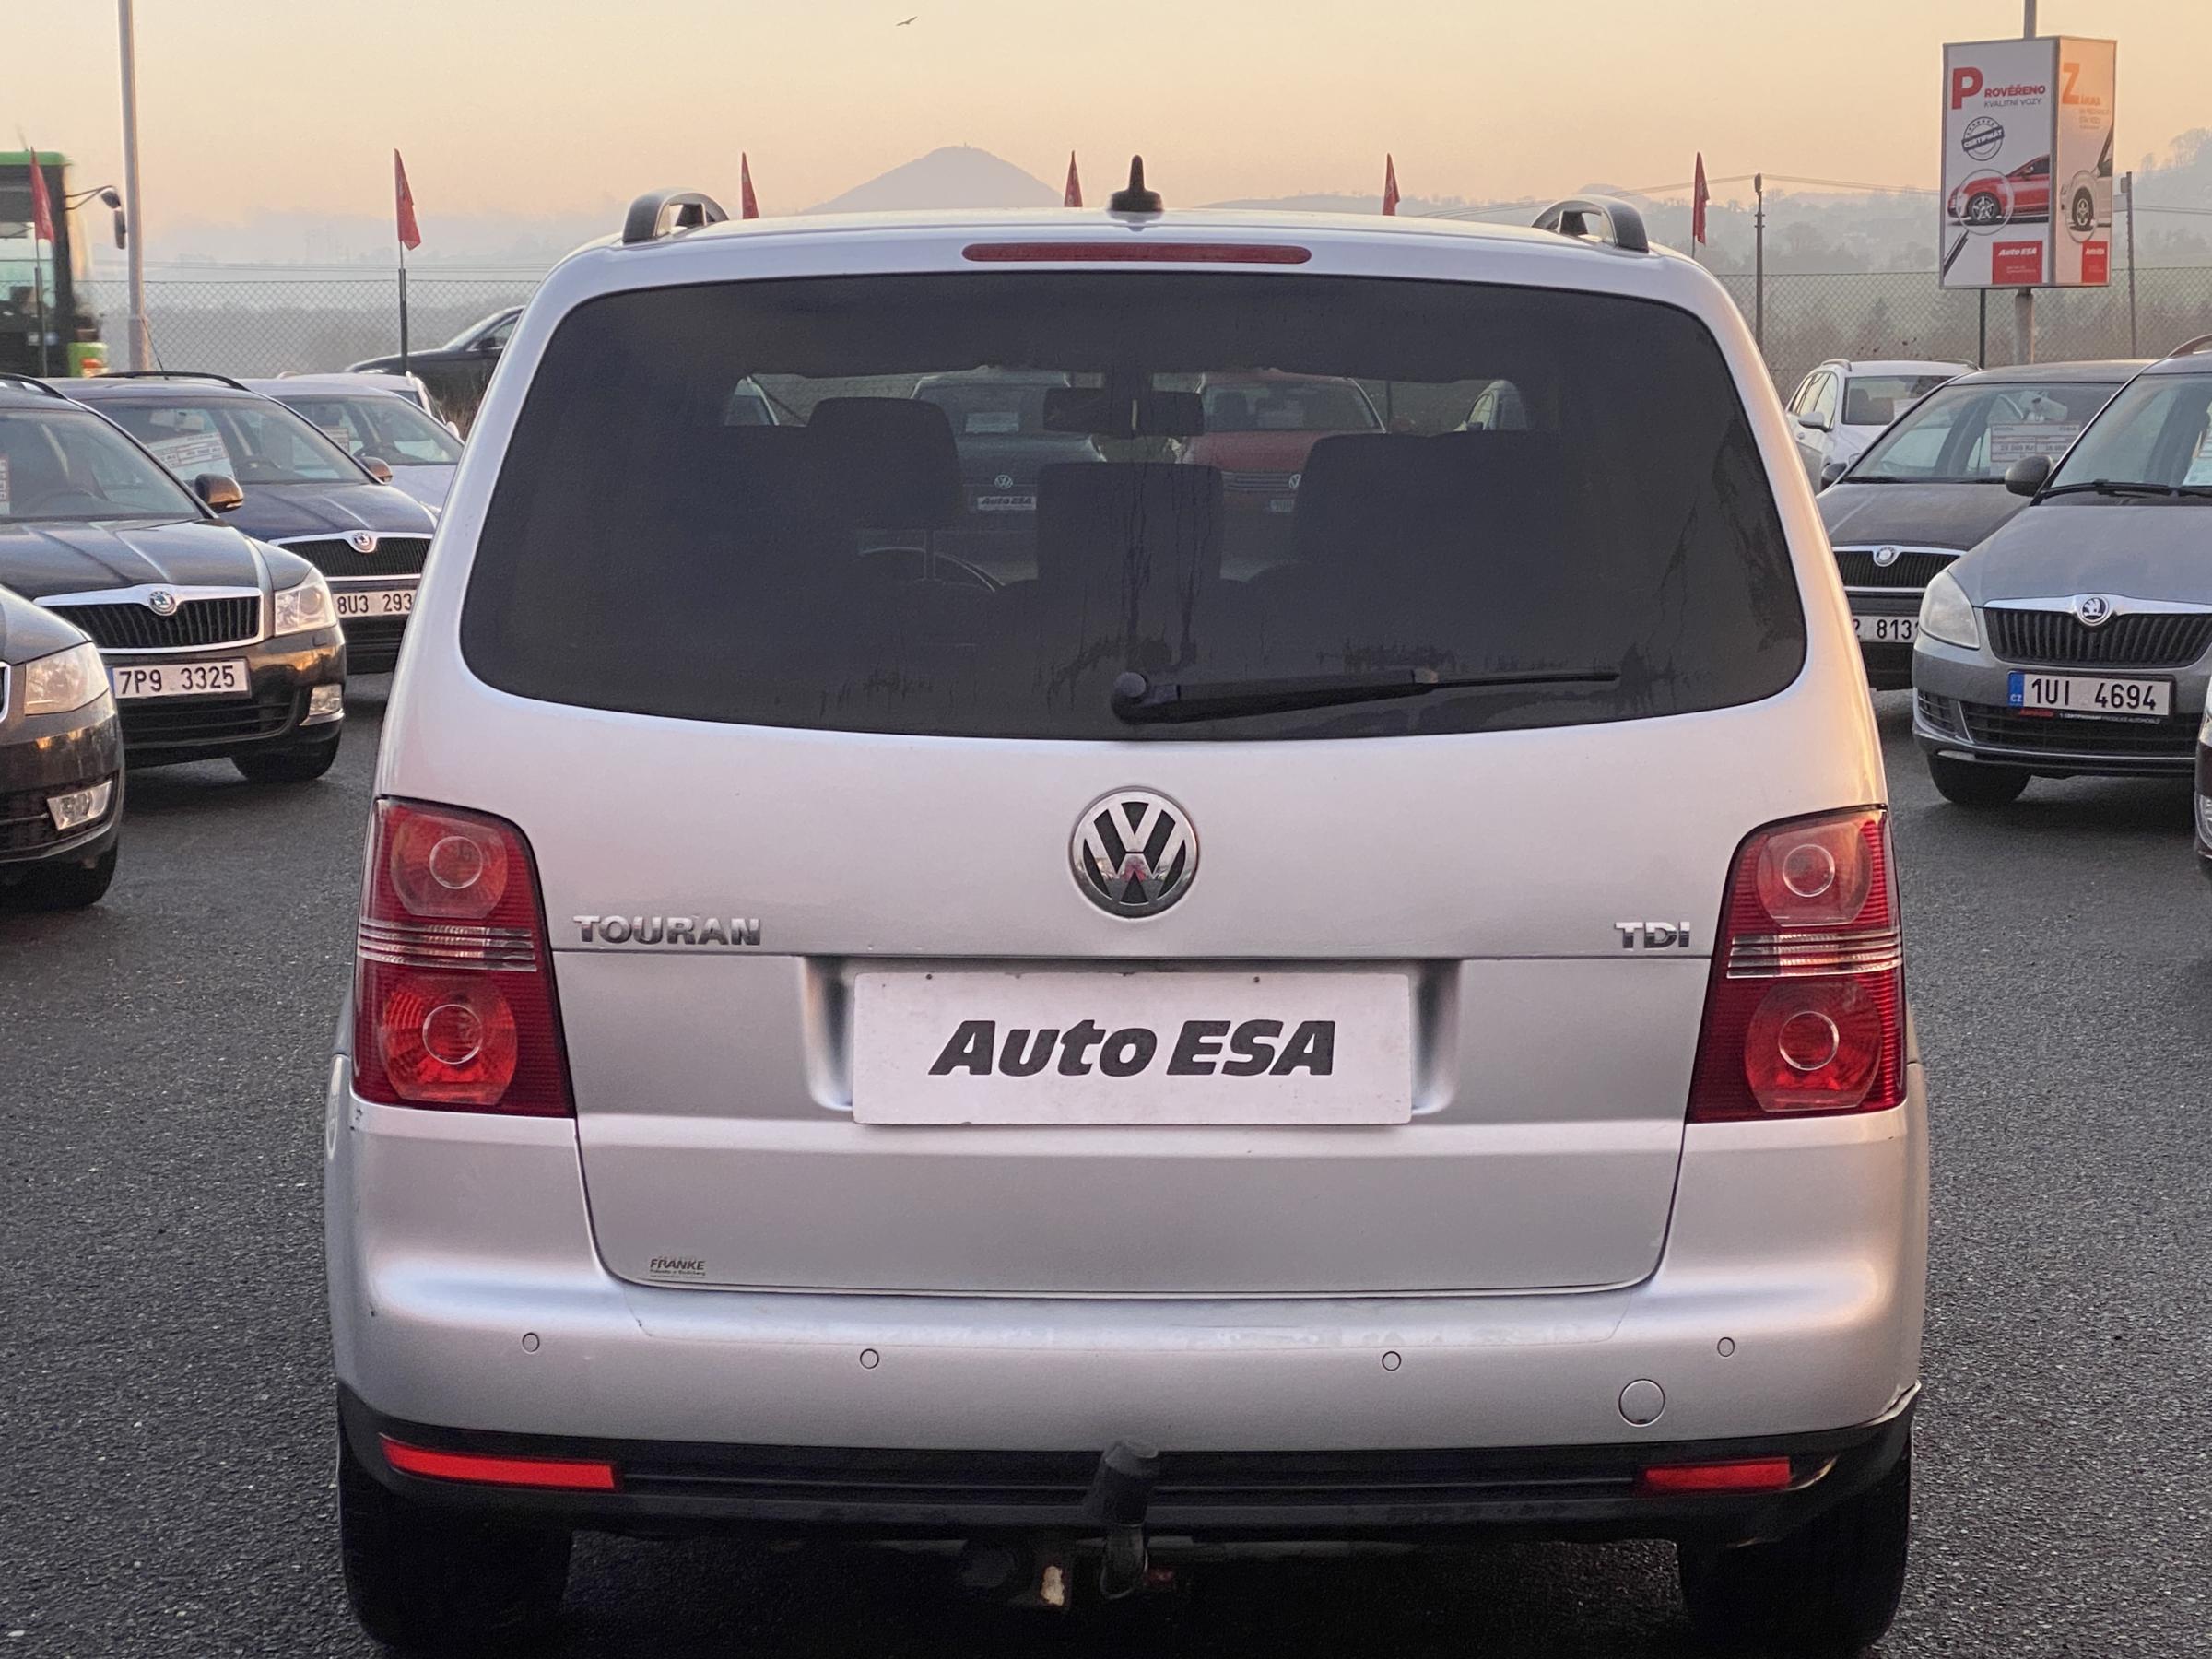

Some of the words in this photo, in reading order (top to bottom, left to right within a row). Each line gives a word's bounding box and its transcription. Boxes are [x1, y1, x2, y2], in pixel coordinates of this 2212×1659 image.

[2019, 98, 2042, 106] VOZY
[2020, 247, 2037, 255] ESA
[337, 595, 369, 614] 8U3
[1877, 619, 1919, 639] 813
[119, 669, 162, 695] 7P9
[180, 665, 235, 690] 3325
[2010, 694, 2022, 702] CZ
[2094, 682, 2157, 711] 4694
[572, 915, 761, 946] TOURAN
[1614, 921, 1690, 948] TDI
[927, 1019, 1158, 1077] Auto
[1166, 1019, 1335, 1076] ESA
[650, 1258, 706, 1270] FRANKE
